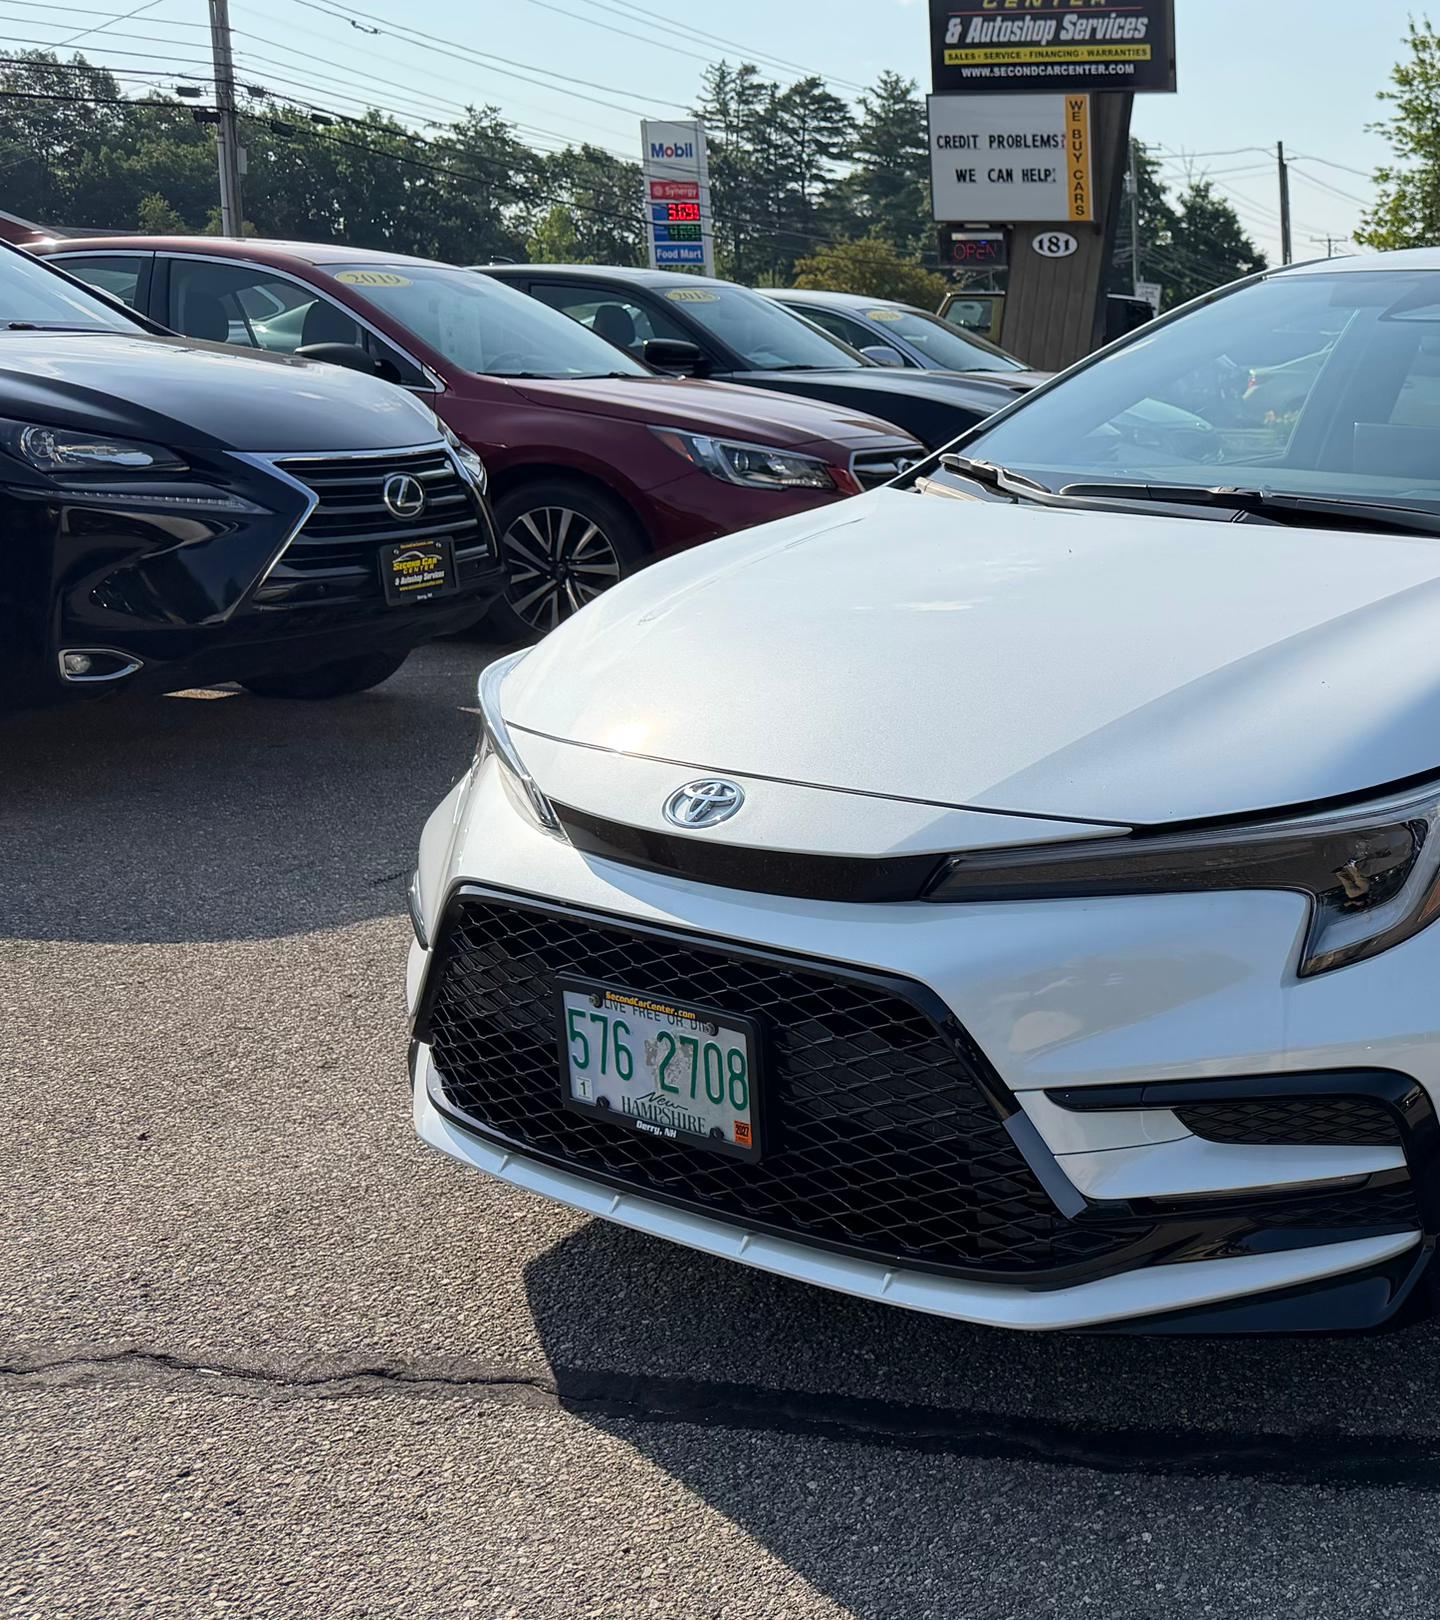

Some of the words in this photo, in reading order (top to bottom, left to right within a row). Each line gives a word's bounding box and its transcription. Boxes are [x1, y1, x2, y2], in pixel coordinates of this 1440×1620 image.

[945, 17, 962, 44] &
[966, 15, 1057, 45] Autoshop
[1060, 13, 1149, 40] Services
[948, 53, 976, 62] SALES
[983, 51, 1021, 61] SERVICE
[1029, 50, 1080, 60] FINANCING
[1087, 49, 1148, 58] WARRANTIES
[961, 63, 1135, 78] WWW.SECONDCARCENTER.COM
[1069, 100, 1083, 122] WE
[650, 142, 693, 158] Mobil
[936, 134, 979, 149] CREDIT
[988, 134, 1066, 149] PROBLEMS?
[1072, 128, 1082, 163] BUY
[955, 168, 977, 183] WE
[987, 168, 1014, 183] CAN
[665, 186, 698, 198] Synergy
[1073, 169, 1085, 215] CARS
[953, 243, 998, 260] OPEN
[1038, 236, 1070, 253] 181
[656, 249, 679, 259] Food
[680, 249, 702, 259] Mart
[603, 998, 627, 1014] LIVE
[632, 1005, 661, 1022] FREE
[666, 1013, 685, 1028] OR
[605, 991, 696, 1019] SecondCarCenter.com
[567, 1007, 634, 1081] 576
[656, 1030, 749, 1111] 2708
[580, 1080, 587, 1096] 1
[635, 1091, 689, 1111] New
[621, 1095, 708, 1135] HAMPSHIRE
[636, 1120, 663, 1136] Derry,
[664, 1128, 677, 1139] NH
